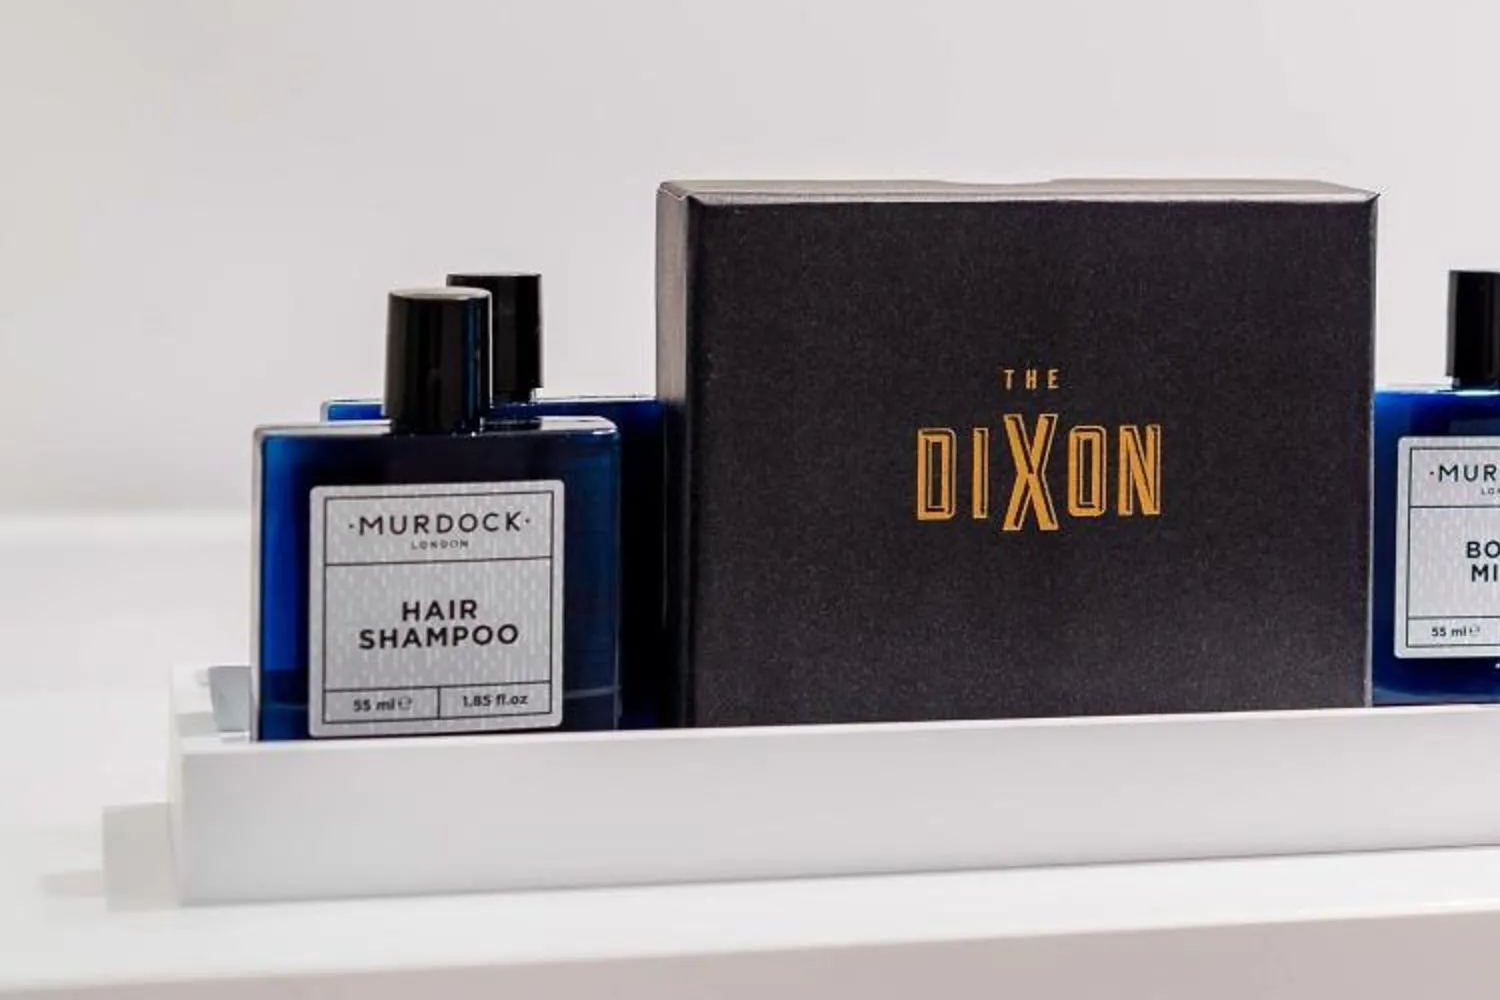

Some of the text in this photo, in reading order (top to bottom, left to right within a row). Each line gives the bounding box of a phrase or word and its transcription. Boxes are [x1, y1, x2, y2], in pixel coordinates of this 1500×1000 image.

[1003, 368, 1060, 390] THE
[917, 413, 1161, 532] DIXON
[411, 540, 469, 550] LONDON
[402, 600, 478, 622] HAIR
[359, 624, 519, 650] SHAMPOO
[1431, 625, 1467, 637] 55 ml
[353, 696, 395, 712] 55 ml
[463, 694, 492, 707] 1.85
